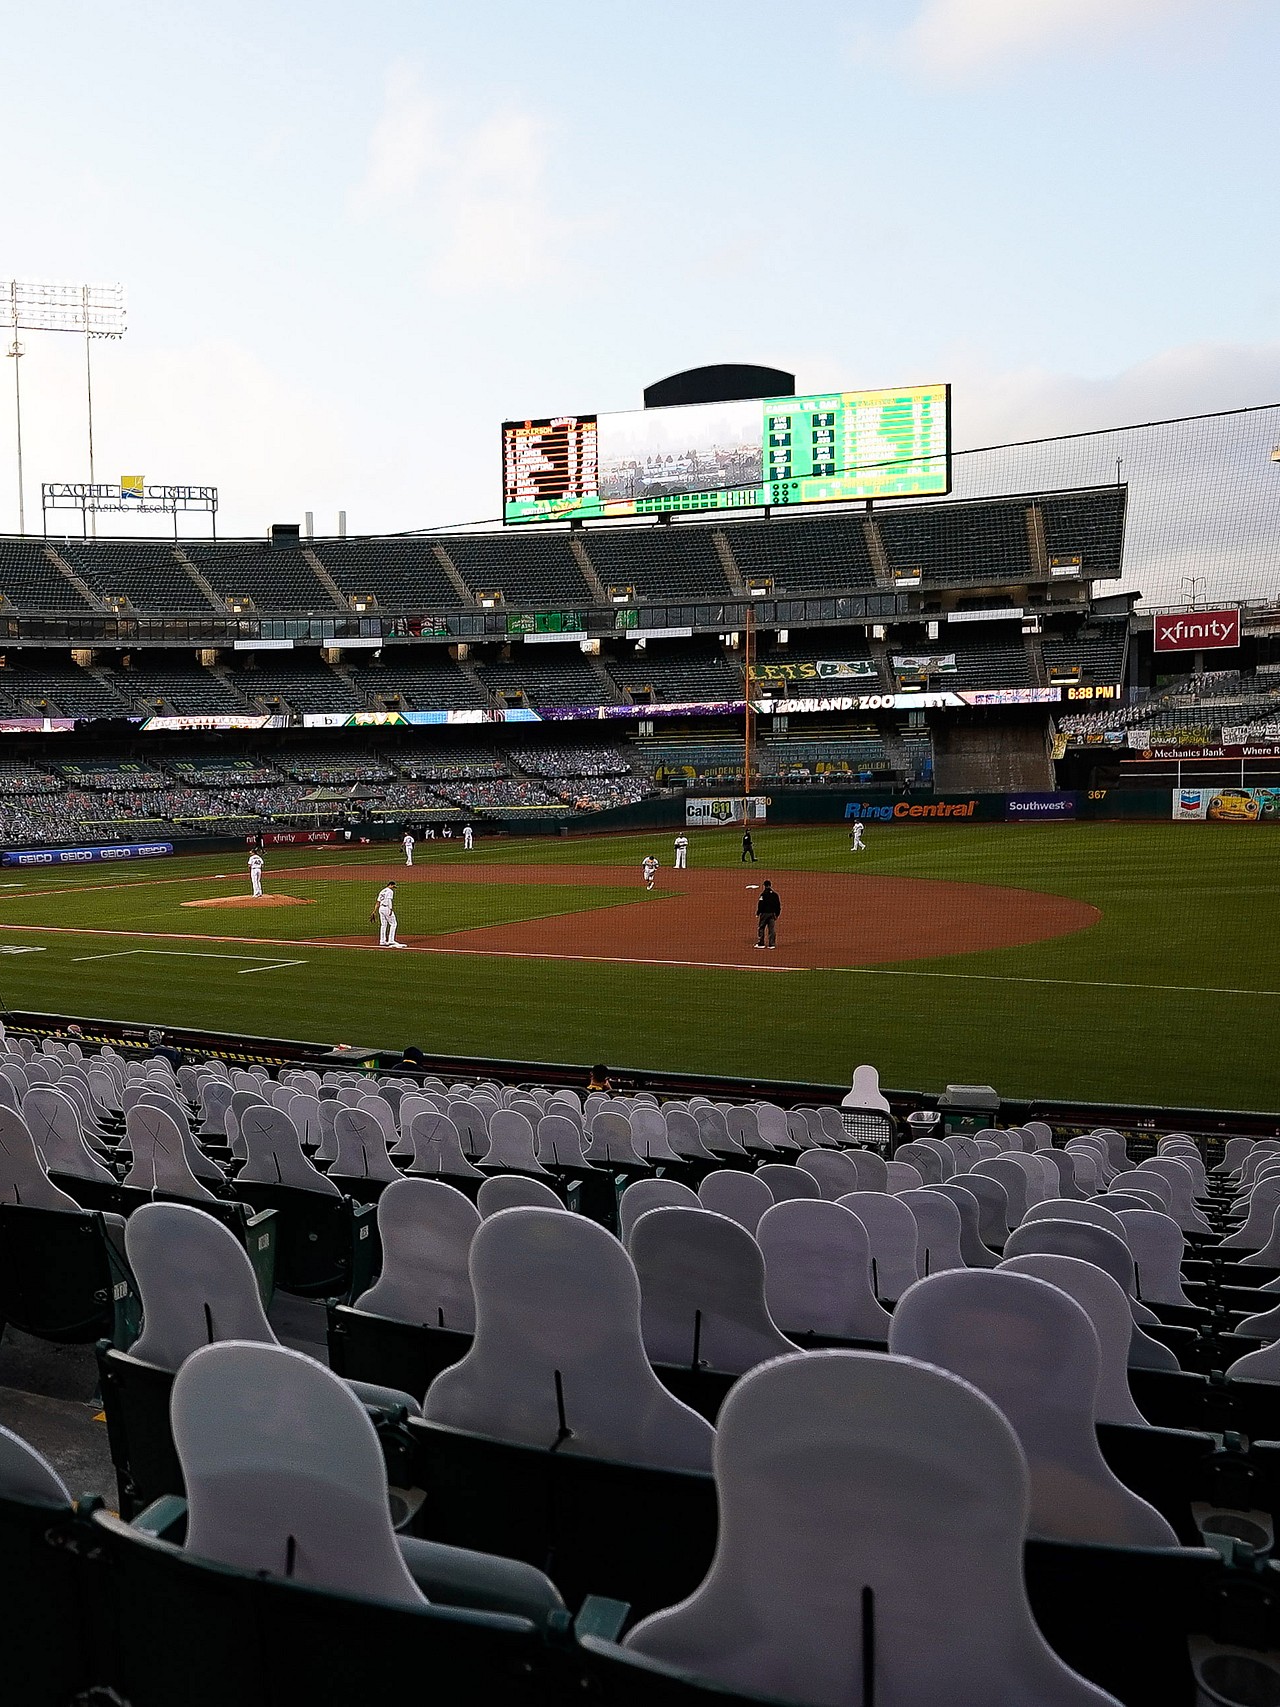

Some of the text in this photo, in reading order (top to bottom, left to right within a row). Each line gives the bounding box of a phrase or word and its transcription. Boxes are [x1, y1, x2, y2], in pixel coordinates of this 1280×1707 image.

[516, 427, 553, 436] DICKERSON
[49, 484, 214, 500] CACHE CREEK
[88, 503, 177, 513] CASINO RESORT
[1160, 619, 1235, 643] xfinity
[1068, 687, 1093, 700] 6:38
[1096, 686, 1114, 698] PM
[789, 695, 895, 712] OAKLAND ZOO
[1154, 748, 1200, 757] Mechanics
[1203, 747, 1224, 756] Bank
[1242, 746, 1272, 755] Where
[1087, 789, 1108, 800] 367
[755, 797, 772, 806] 330
[1008, 800, 1065, 811] Southwest
[686, 801, 730, 817] Call 811
[845, 800, 975, 820] RingCentral
[272, 833, 296, 844] xfinity
[307, 832, 331, 842] xfinity
[19, 854, 53, 865] GEICO
[60, 851, 93, 861] GEICO
[100, 848, 131, 858] GEICO
